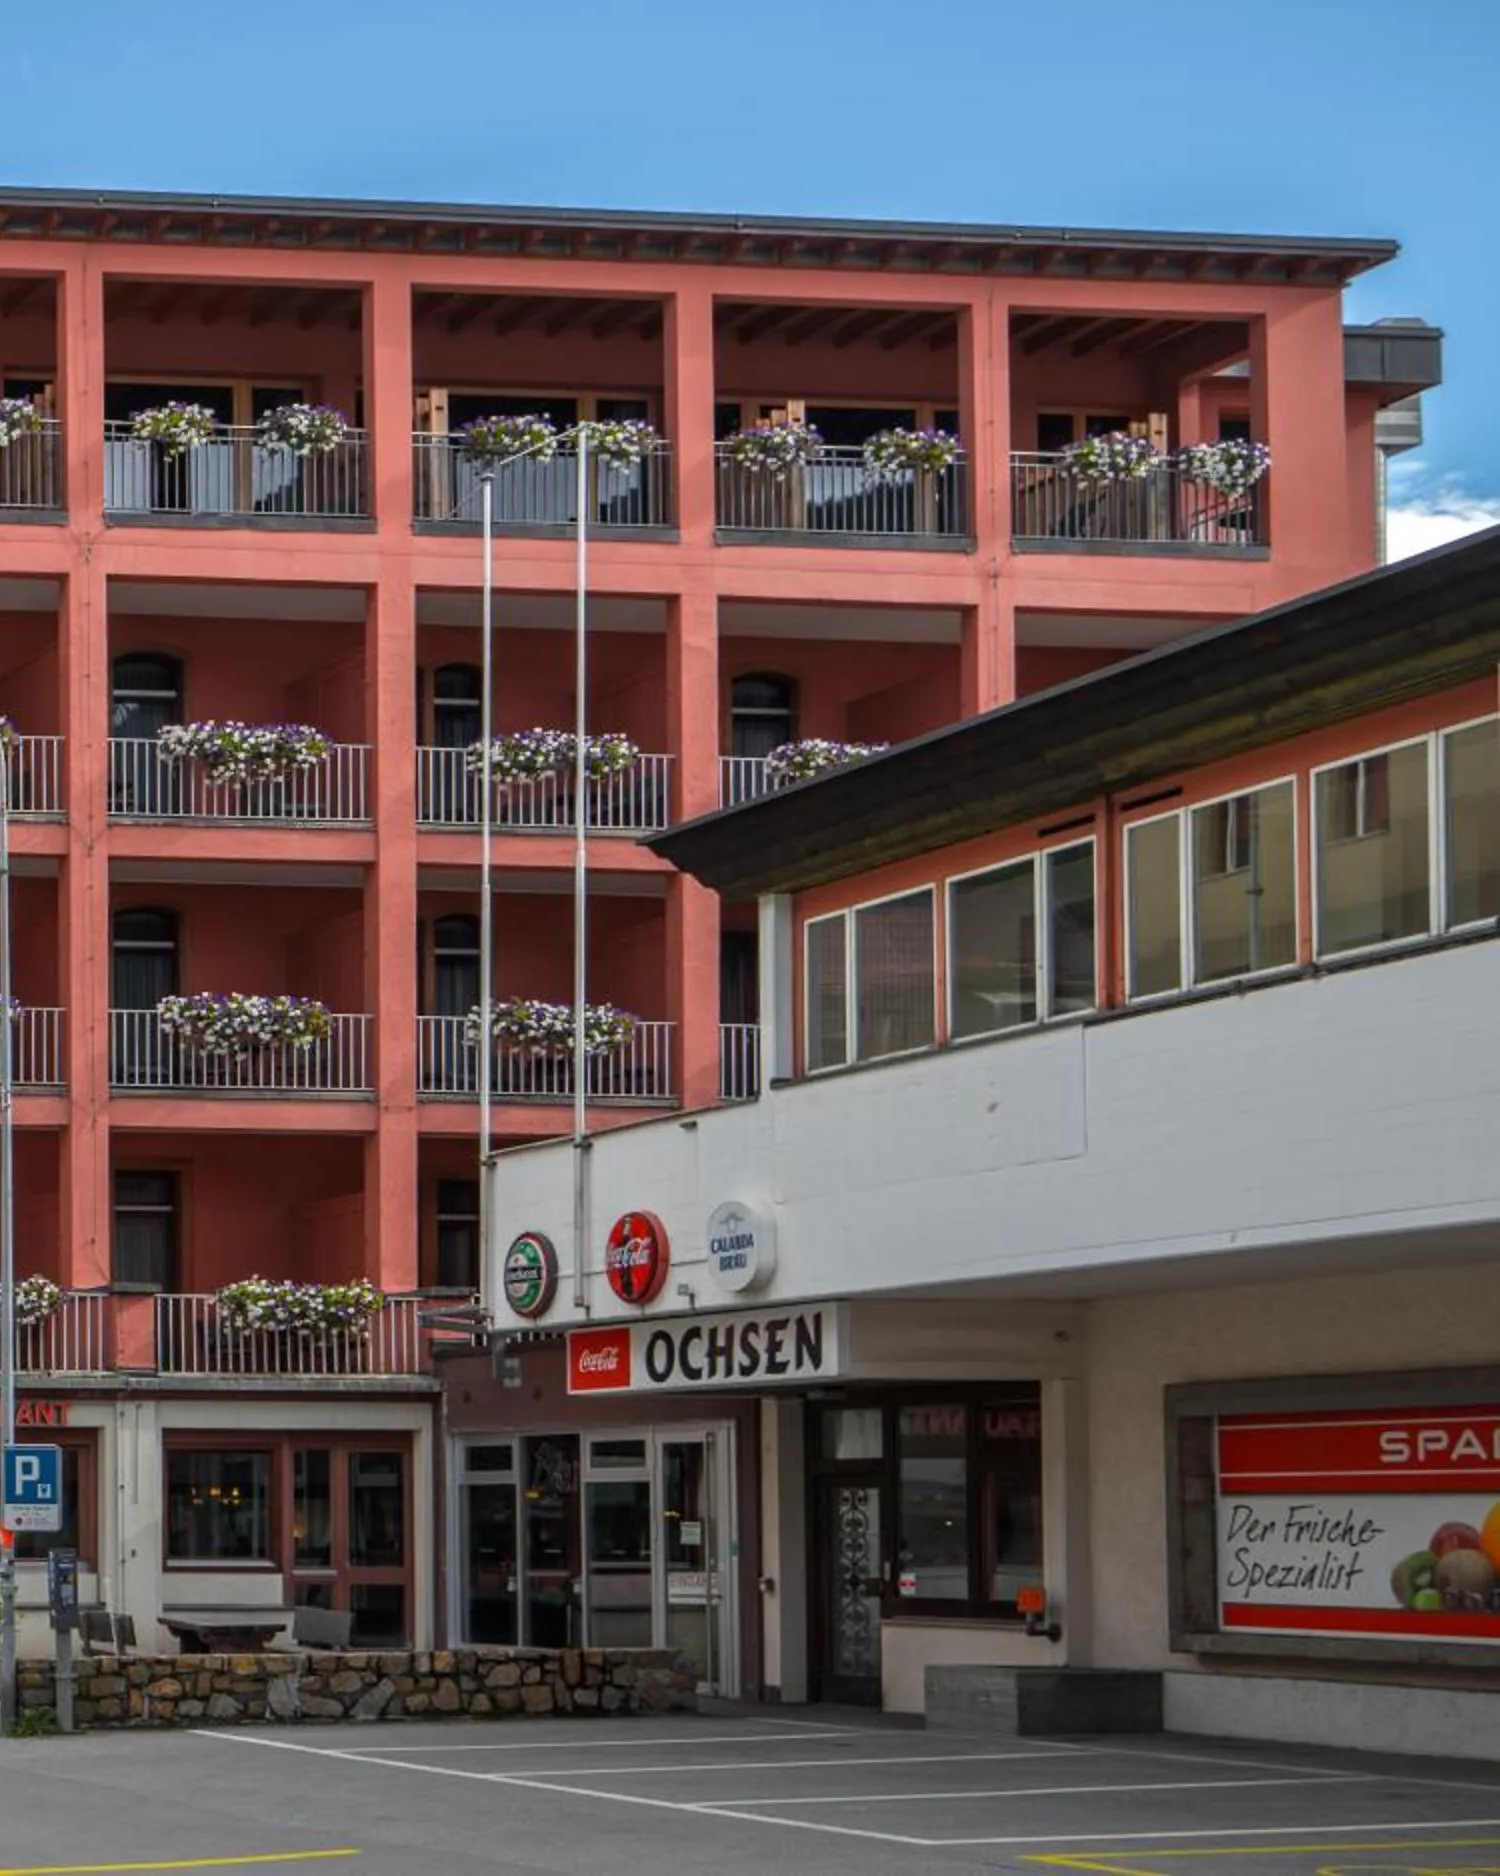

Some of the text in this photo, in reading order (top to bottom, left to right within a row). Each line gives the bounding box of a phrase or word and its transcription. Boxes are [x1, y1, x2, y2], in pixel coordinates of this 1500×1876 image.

[646, 1312, 822, 1383] OCHSEN
[1380, 1428, 1500, 1462] SPA
[15, 1455, 40, 1496] P
[1227, 1504, 1386, 1546] Der Frische-
[1227, 1548, 1363, 1598] Spezialist
